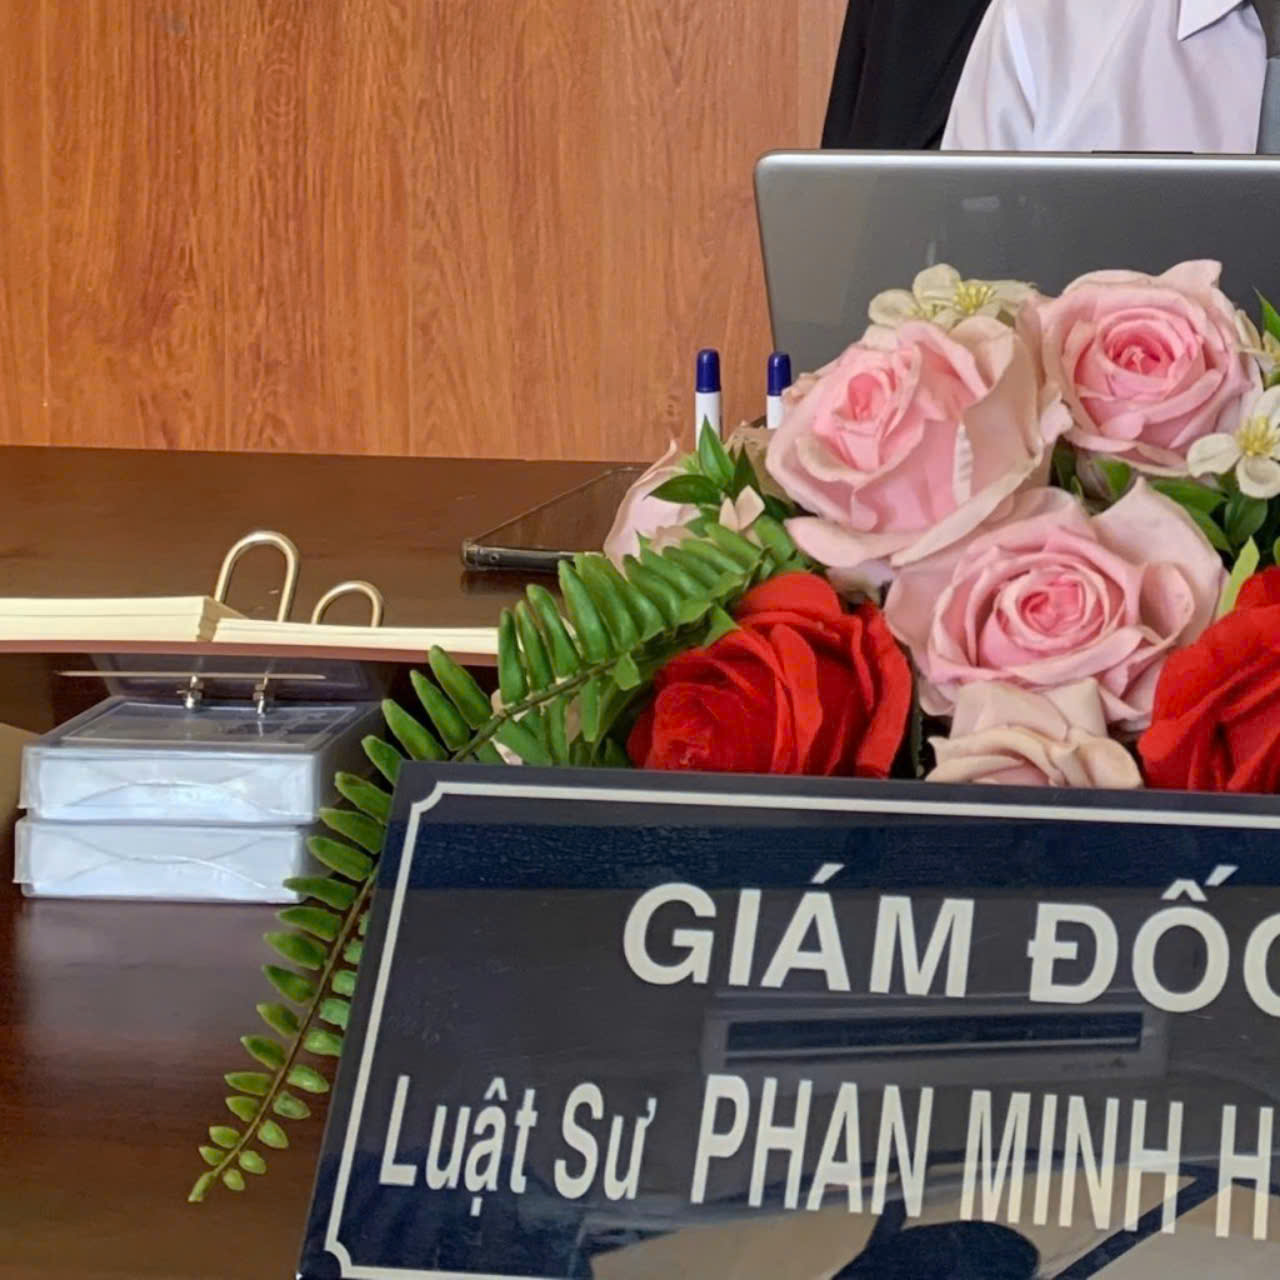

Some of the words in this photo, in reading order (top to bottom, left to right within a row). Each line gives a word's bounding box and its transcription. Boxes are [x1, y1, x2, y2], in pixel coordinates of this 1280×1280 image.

[623, 863, 975, 998] GIÁM
[379, 1075, 538, 1217] Luật
[554, 1083, 657, 1201] Sư
[690, 1073, 934, 1218] PHAN
[959, 1089, 1184, 1235] MINH
